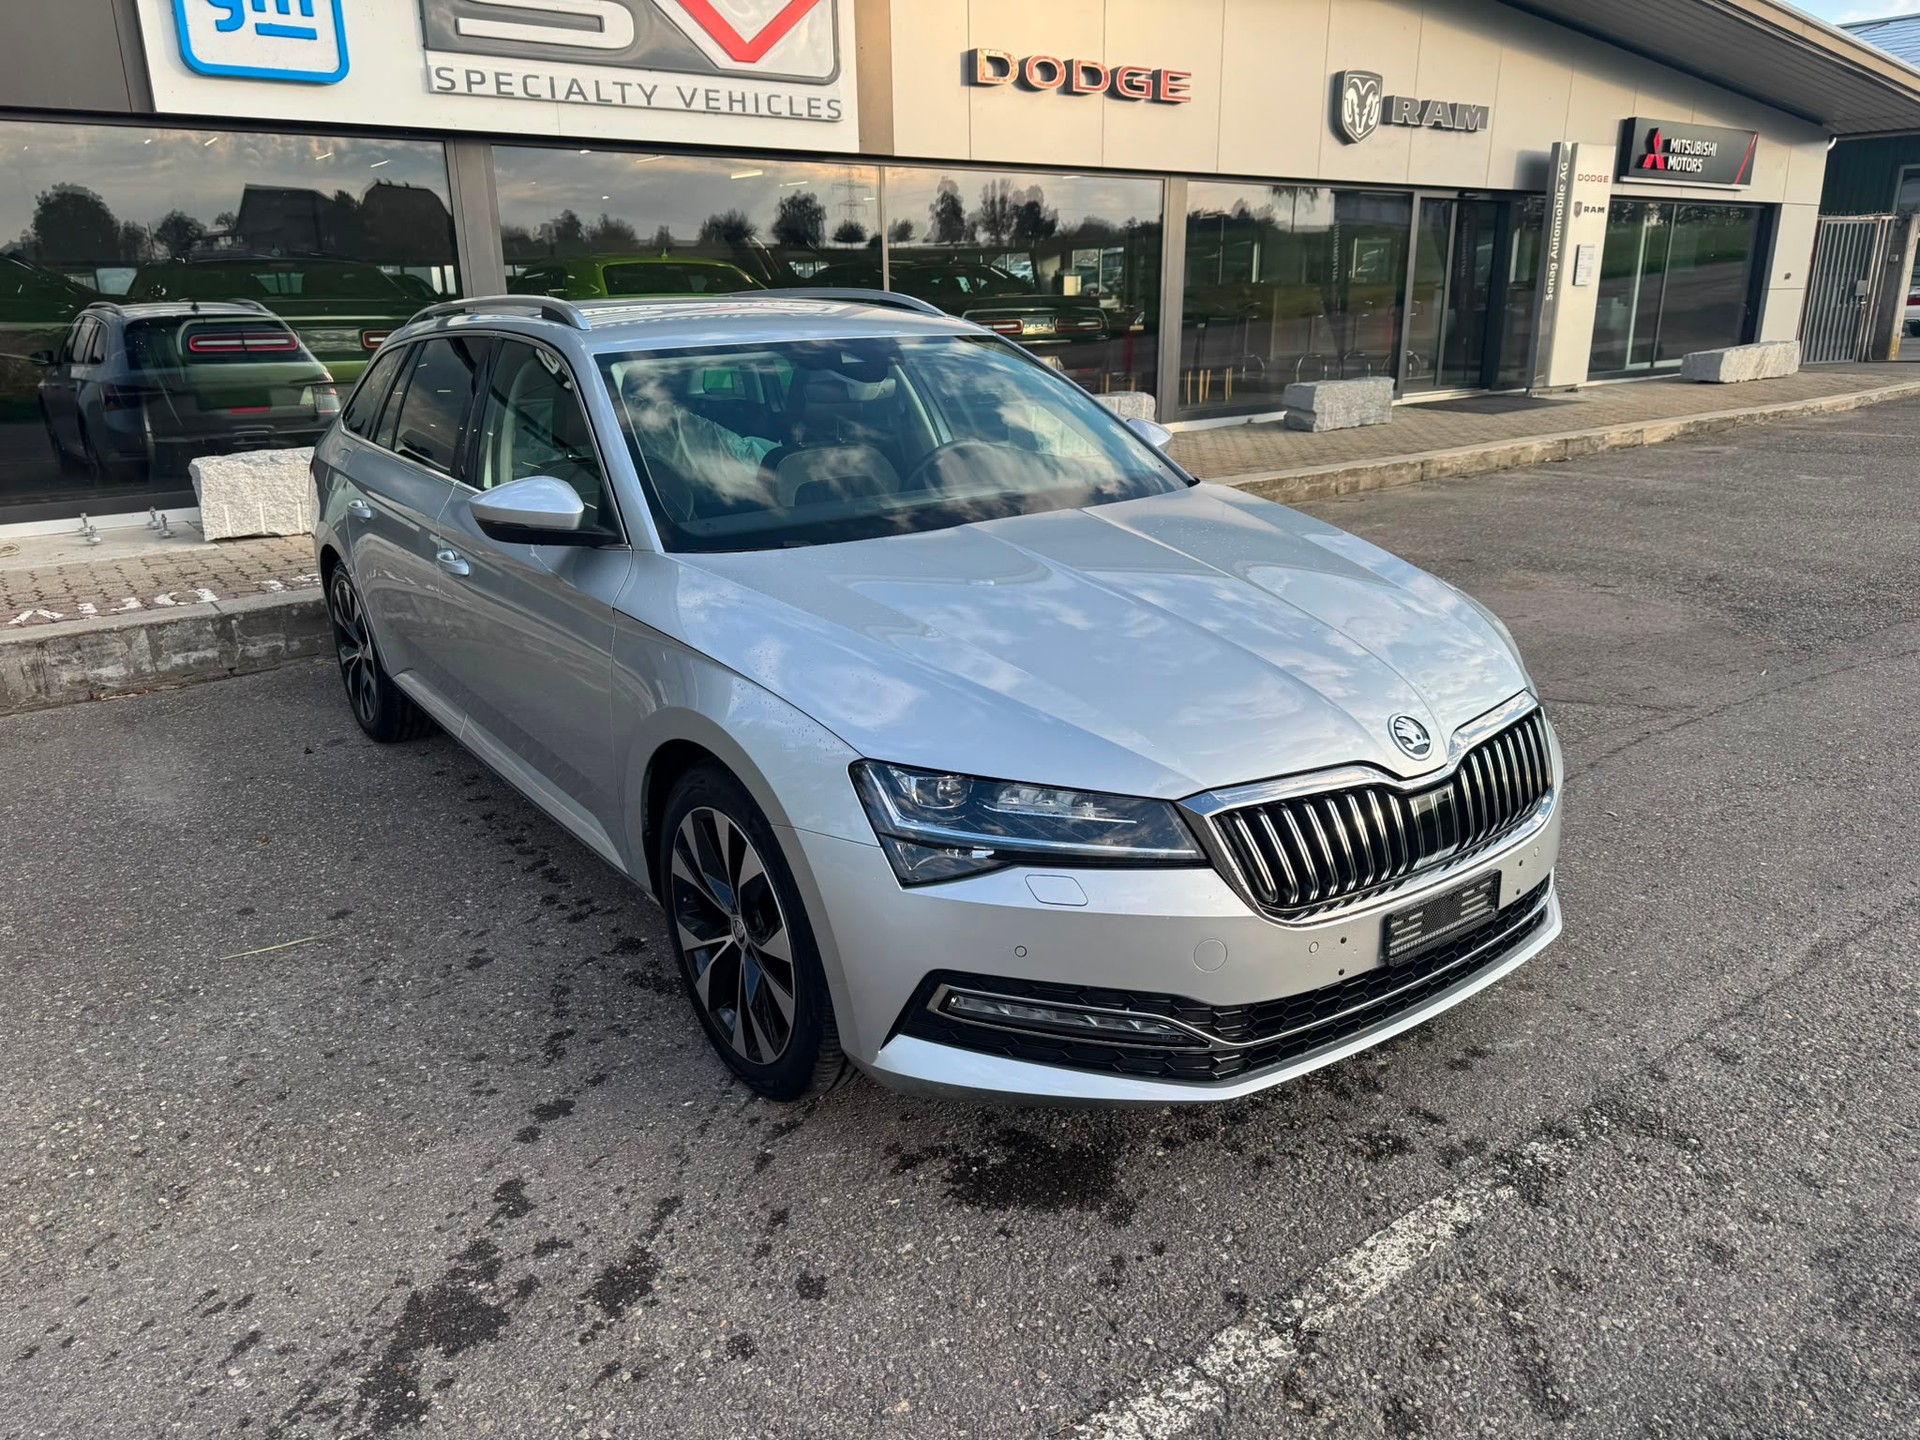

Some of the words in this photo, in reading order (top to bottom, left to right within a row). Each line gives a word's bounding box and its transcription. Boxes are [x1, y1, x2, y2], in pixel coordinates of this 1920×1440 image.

[970, 48, 1192, 103] DODGE
[435, 66, 658, 107] SPECIALTY
[676, 85, 843, 120] VEHICLES
[1387, 95, 1490, 132] RAM
[1670, 137, 1718, 157] MITSUBISHI
[1559, 162, 1569, 181] AG
[1577, 173, 1610, 183] DODGE
[1667, 155, 1704, 173] MOTORS
[1550, 184, 1567, 259] Automobile
[1583, 205, 1606, 214] RAM
[1544, 262, 1559, 301] Senag
